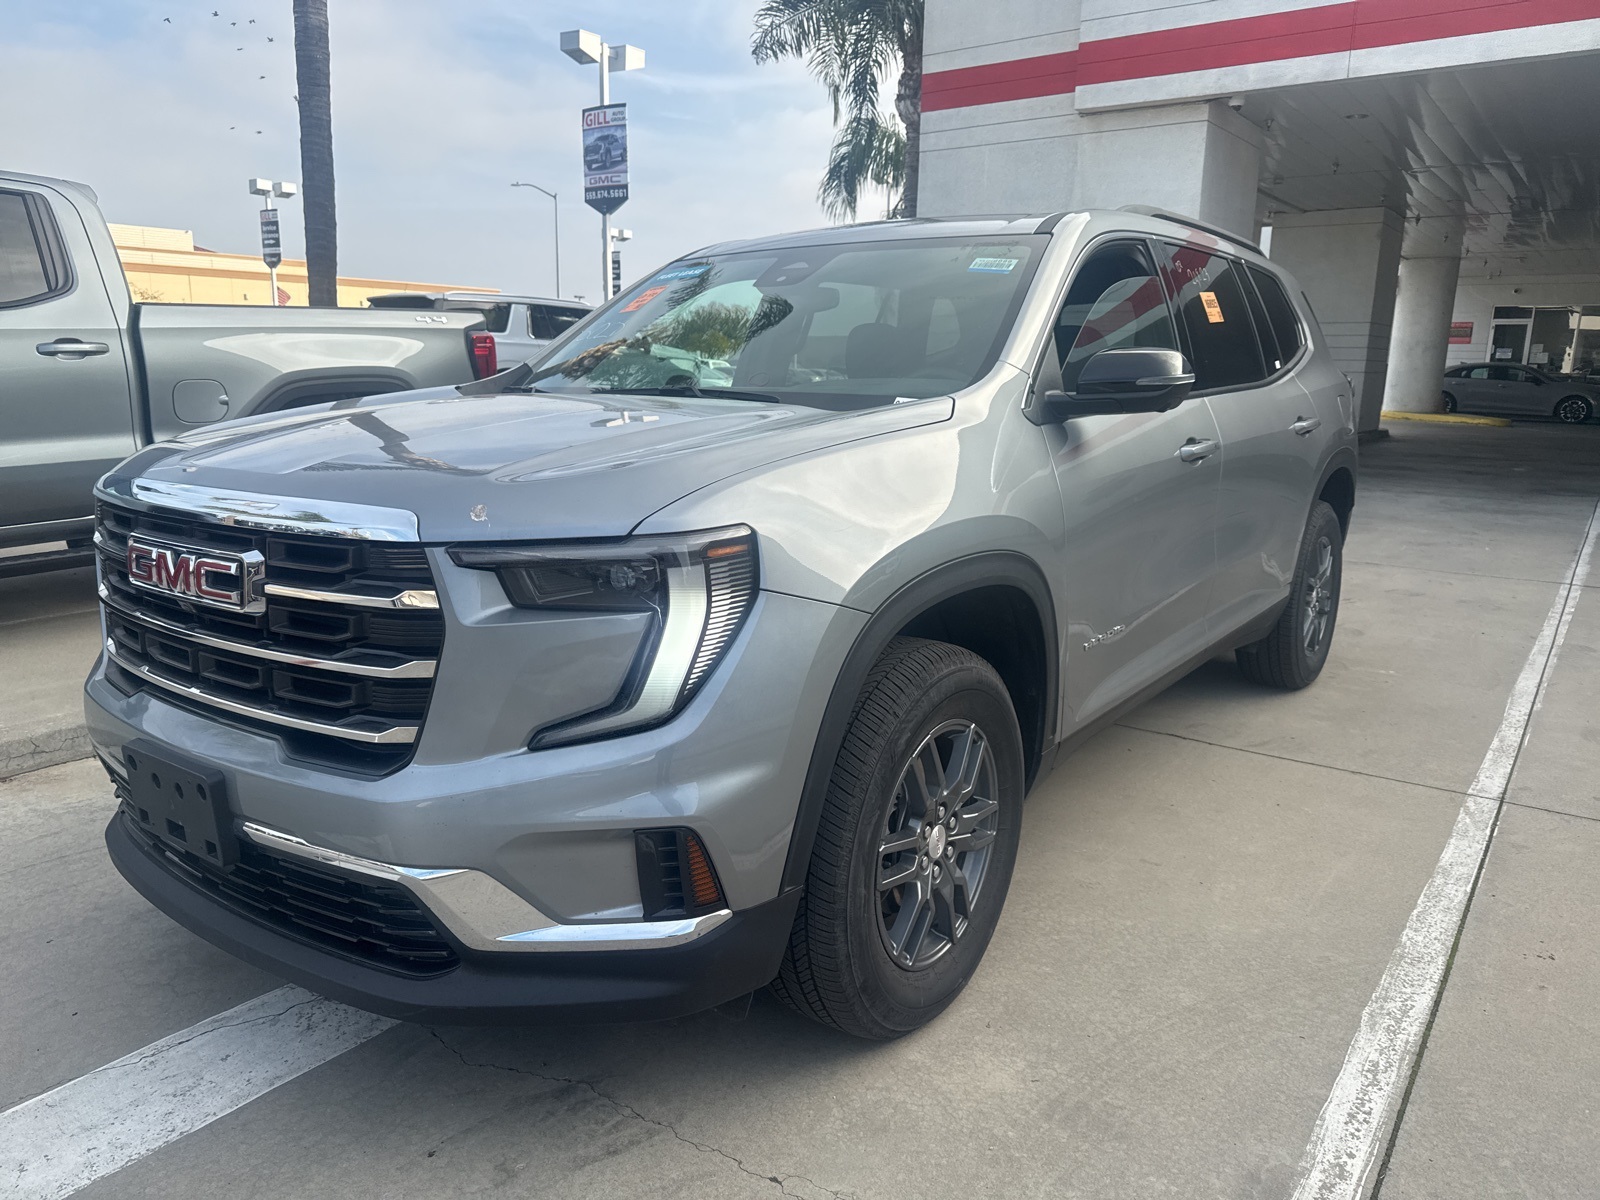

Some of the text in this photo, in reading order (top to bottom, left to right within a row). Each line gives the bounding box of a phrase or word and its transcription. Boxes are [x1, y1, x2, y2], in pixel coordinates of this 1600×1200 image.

[585, 111, 610, 127] GILL
[589, 175, 621, 186] GMC
[128, 543, 241, 604] GMC
[1083, 624, 1126, 652] ACADIA
